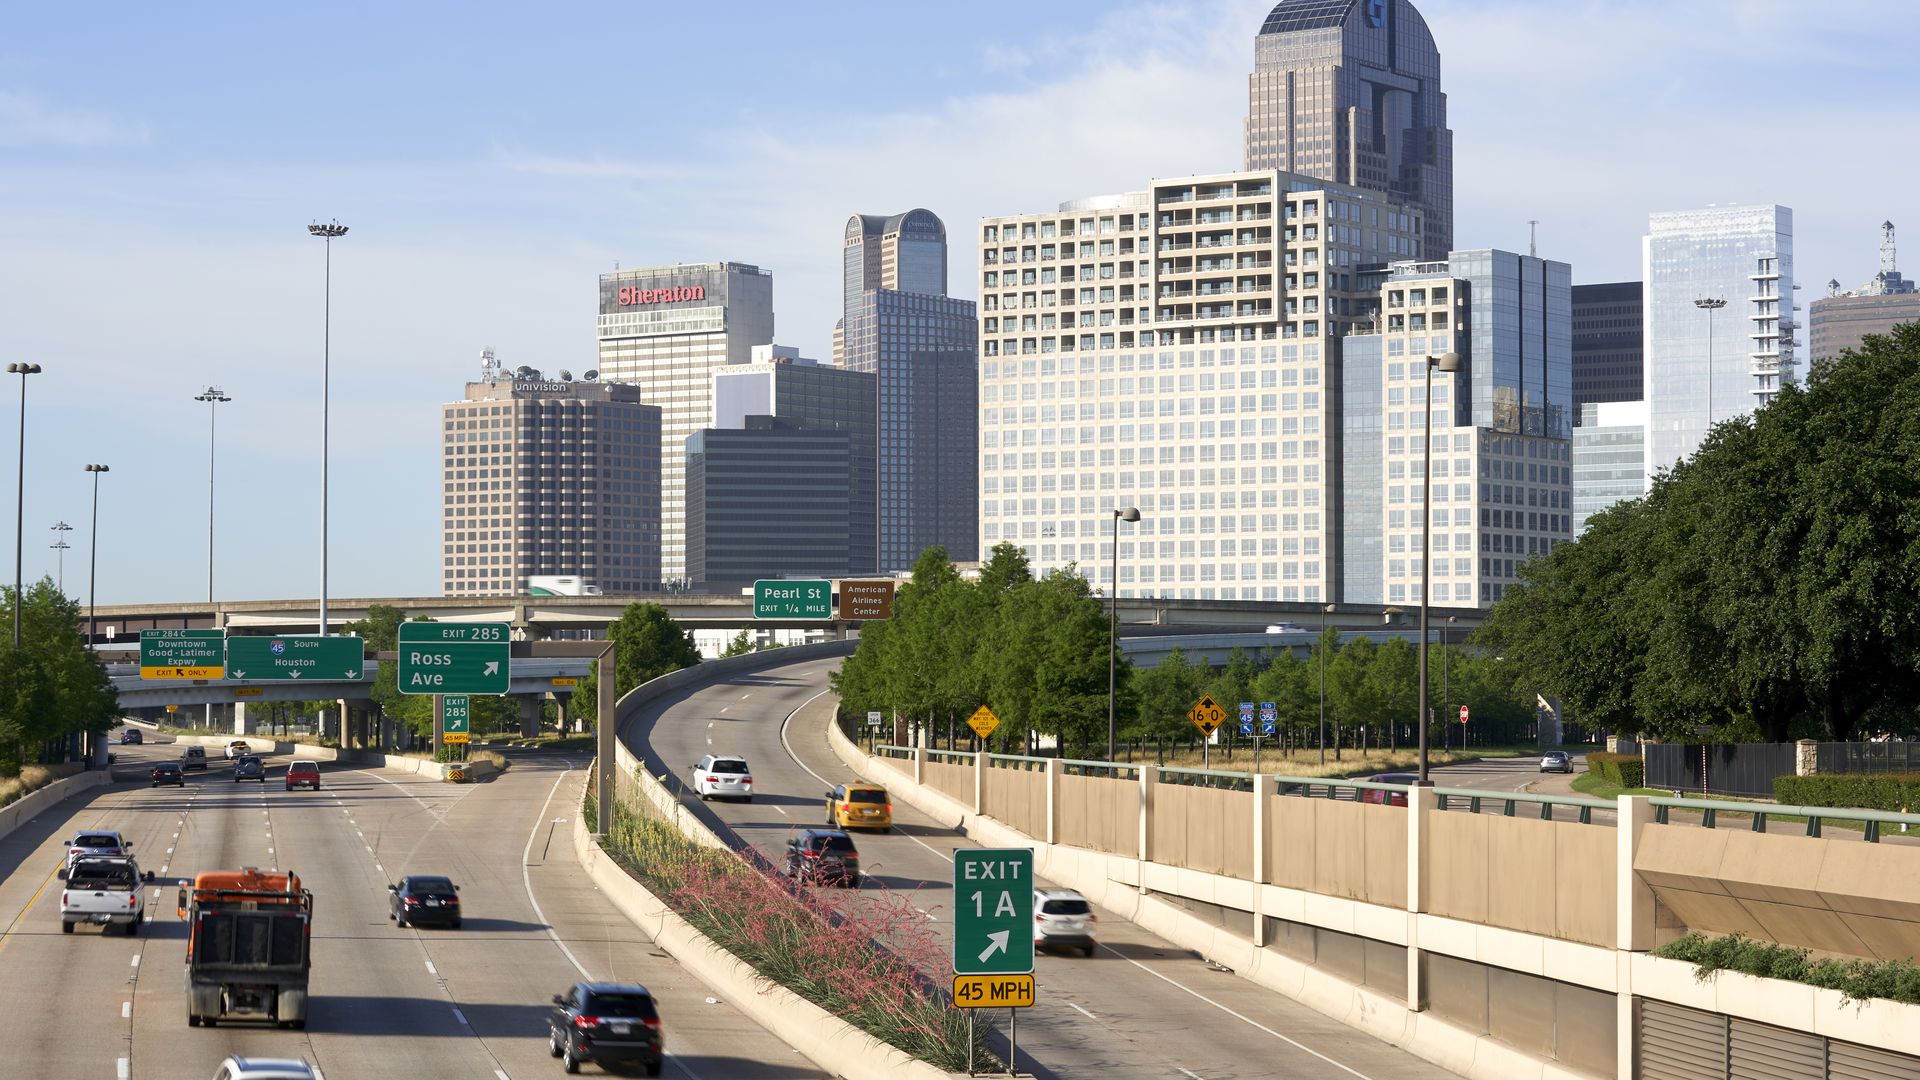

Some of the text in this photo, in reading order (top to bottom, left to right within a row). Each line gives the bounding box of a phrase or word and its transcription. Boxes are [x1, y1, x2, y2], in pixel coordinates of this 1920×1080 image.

[618, 285, 705, 306] Sheraton
[515, 383, 566, 391] univision
[764, 588, 821, 599] Pearl St
[785, 604, 800, 613] 1/4
[162, 630, 179, 638] 284
[442, 628, 500, 640] EXIT 285
[158, 640, 207, 648] Downtown
[271, 644, 285, 652] 45
[148, 649, 173, 657] Good
[180, 649, 216, 657] Latimer
[168, 658, 197, 667] Expwy
[275, 658, 316, 667] Houston
[410, 652, 452, 665] Ross
[411, 672, 444, 686] Ave
[446, 698, 466, 706] EXIT
[446, 707, 467, 717] 285
[1192, 709, 1205, 721] 16
[1210, 709, 1219, 721] 0
[1241, 714, 1252, 722] 45
[965, 861, 1023, 880] EXIT
[958, 982, 1030, 1000] 45 MPH
